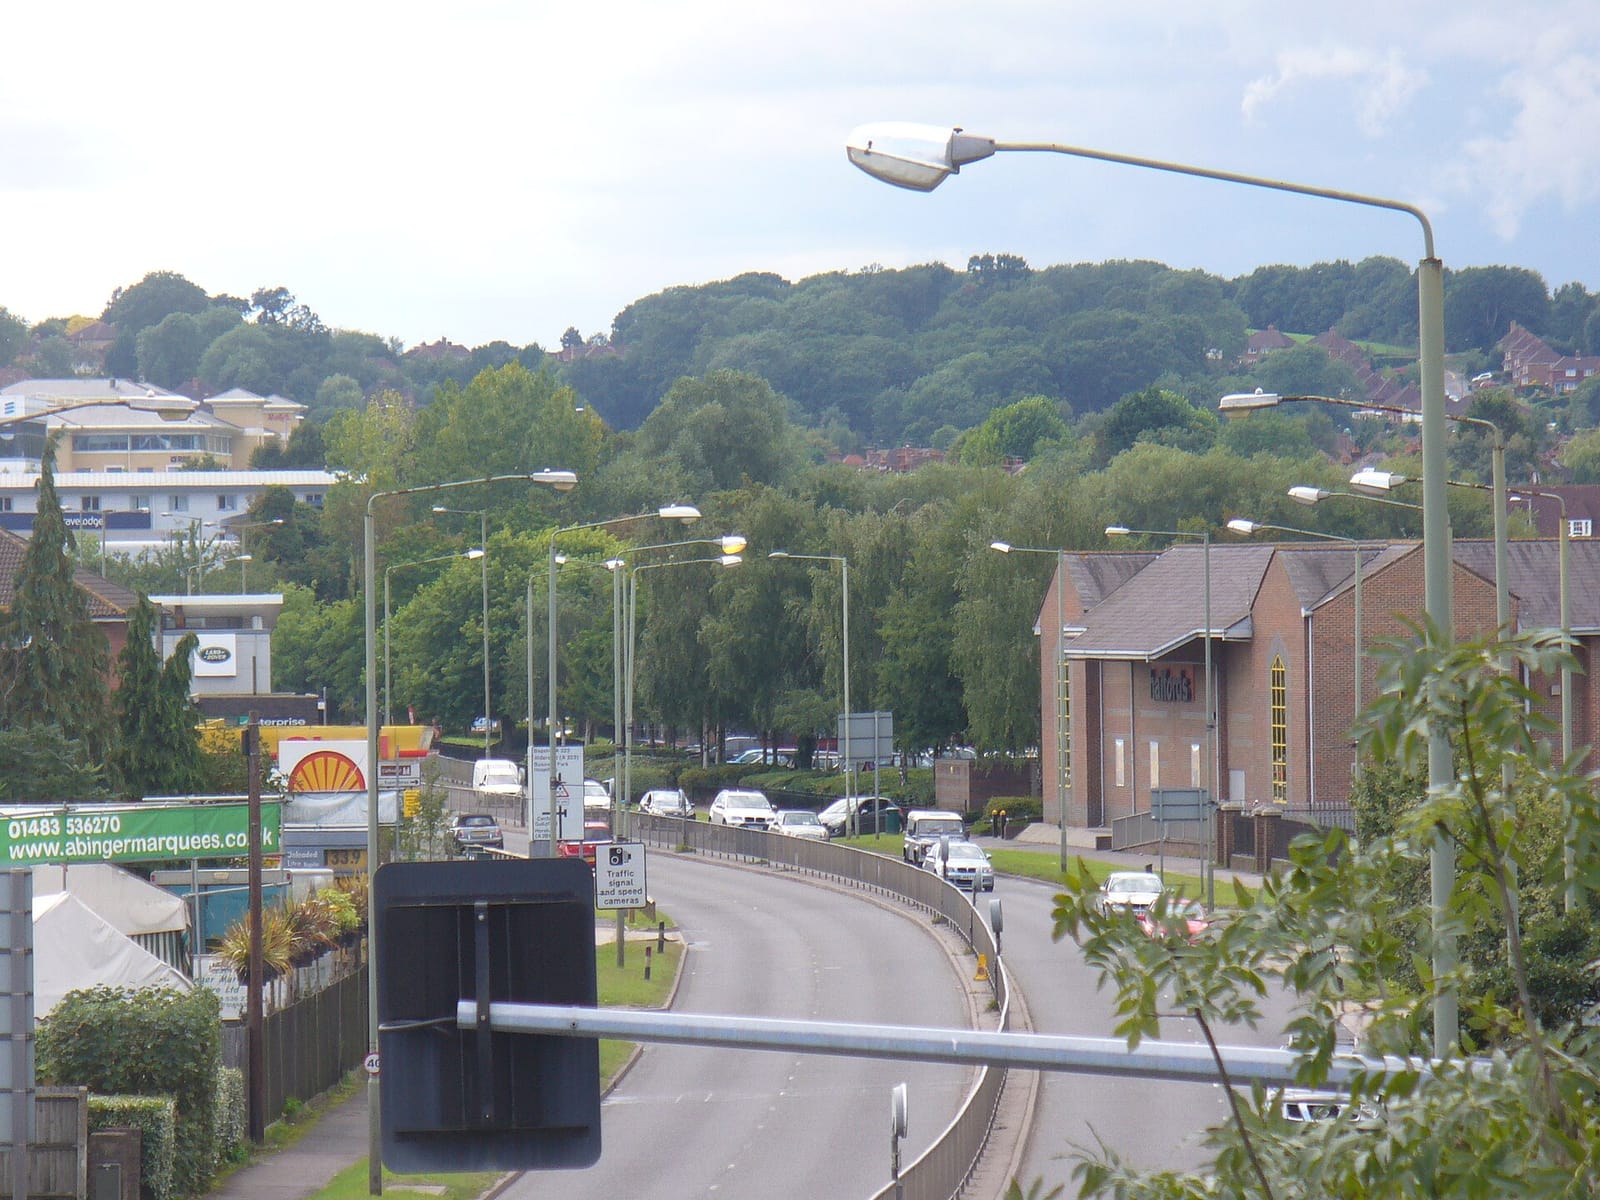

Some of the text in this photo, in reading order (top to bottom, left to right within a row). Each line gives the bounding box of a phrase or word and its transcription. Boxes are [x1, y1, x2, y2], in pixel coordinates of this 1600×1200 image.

[8, 816, 121, 838] 01483 536270
[8, 827, 273, 860] www.abingermarquees.co.k
[607, 870, 635, 878] Traffic
[609, 879, 634, 888] signal
[600, 887, 643, 896] and speed
